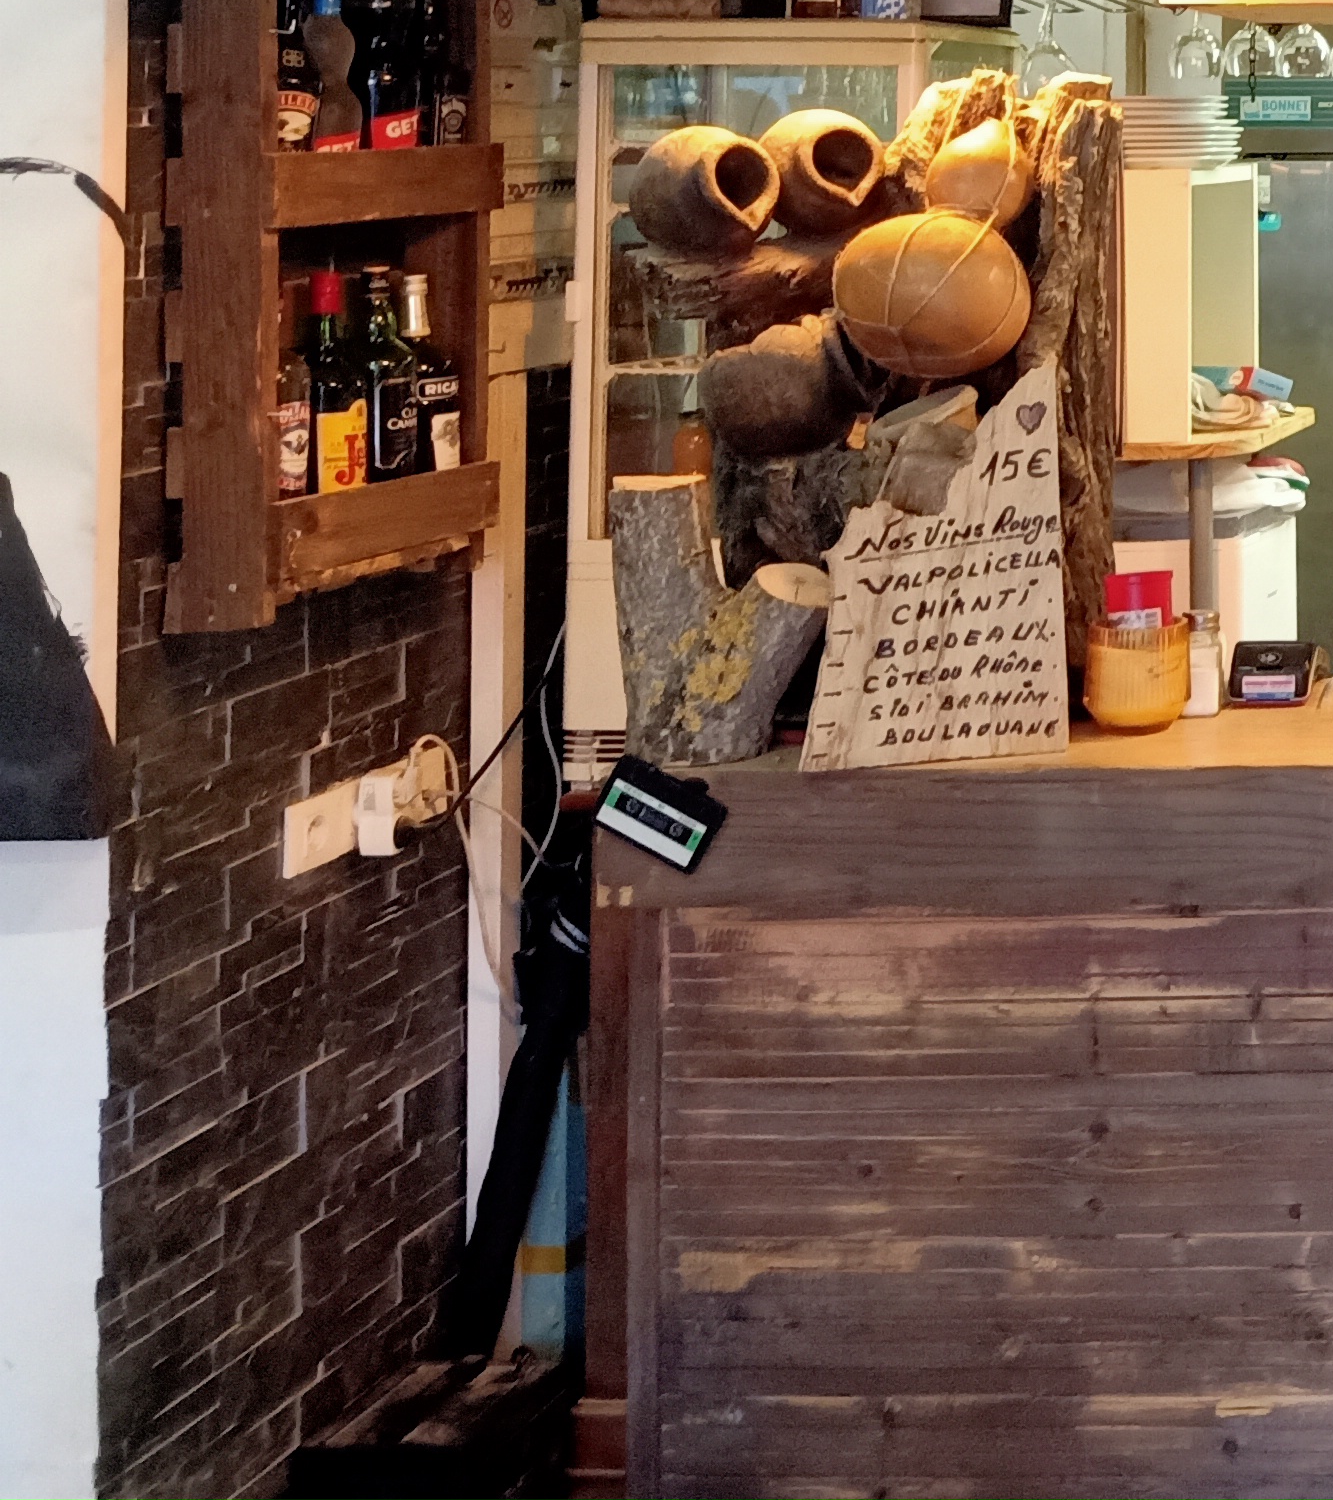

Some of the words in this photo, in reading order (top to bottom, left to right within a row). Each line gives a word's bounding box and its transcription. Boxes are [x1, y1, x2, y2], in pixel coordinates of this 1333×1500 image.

[1261, 100, 1309, 112] BONNET
[386, 115, 418, 138] GET
[424, 381, 457, 396] RICA
[979, 448, 1052, 486] 15€
[877, 718, 1059, 747] BOULAOUANE
